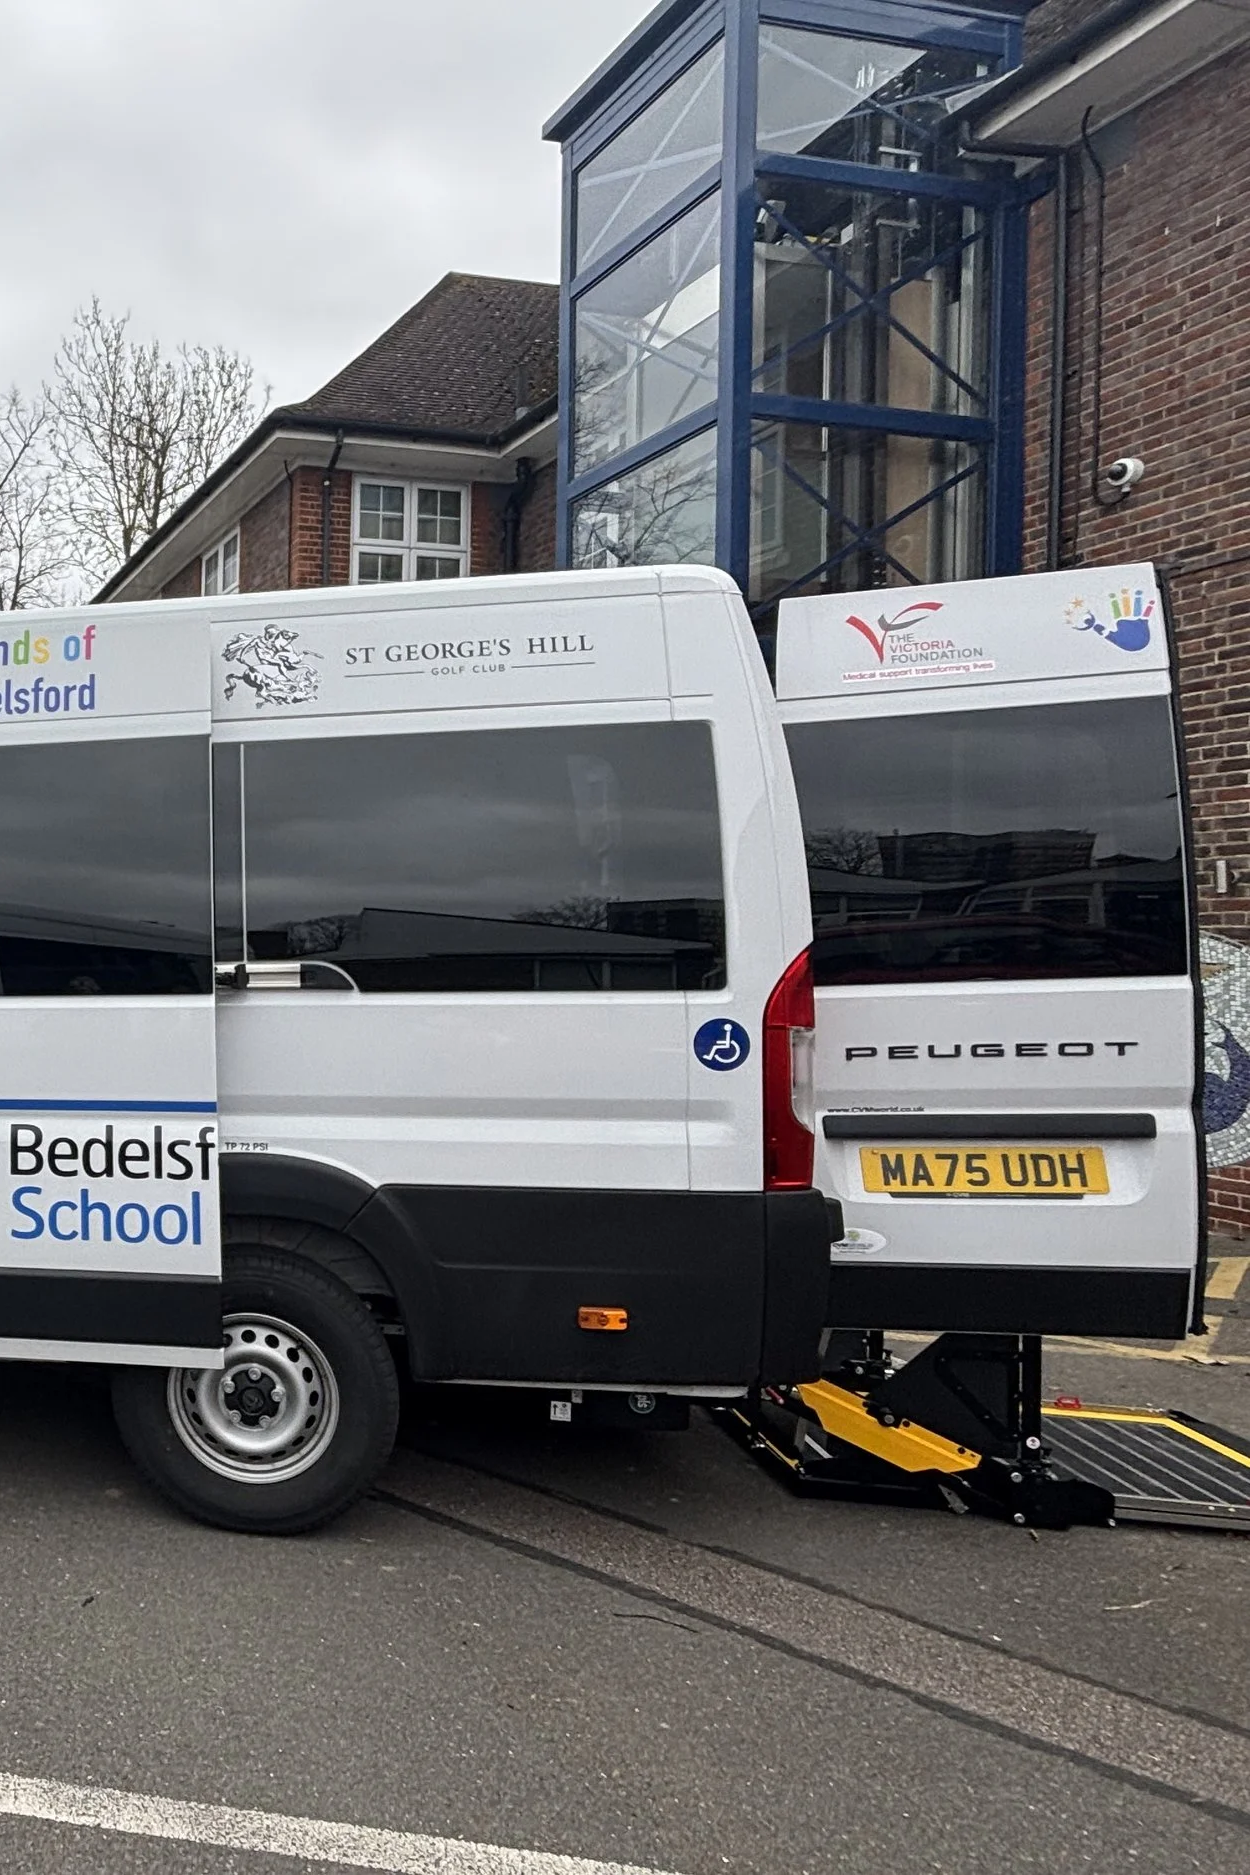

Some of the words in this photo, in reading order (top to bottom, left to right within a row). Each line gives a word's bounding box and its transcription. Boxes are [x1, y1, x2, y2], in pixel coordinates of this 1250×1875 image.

[63, 624, 97, 663] of
[888, 632, 915, 644] THE
[890, 639, 955, 654] VICTORIA
[345, 646, 376, 665] ST
[384, 637, 512, 662] GEORGE'S
[527, 634, 595, 655] HILL
[890, 647, 983, 664] FOUNDATION
[430, 665, 465, 677] GOLF
[473, 662, 506, 673] CLUB
[842, 672, 876, 681] Medical
[879, 668, 913, 678] support
[915, 663, 970, 675] transforming
[973, 661, 994, 670] lives
[845, 1041, 1141, 1061] PEUGEOT
[9, 1123, 217, 1182] Bedelsf
[225, 1142, 238, 1151] TP
[239, 1142, 251, 1151] 72
[252, 1142, 269, 1151] PSI
[880, 1152, 990, 1188] MA75
[1000, 1152, 1089, 1189] UDH
[10, 1185, 202, 1246] School
